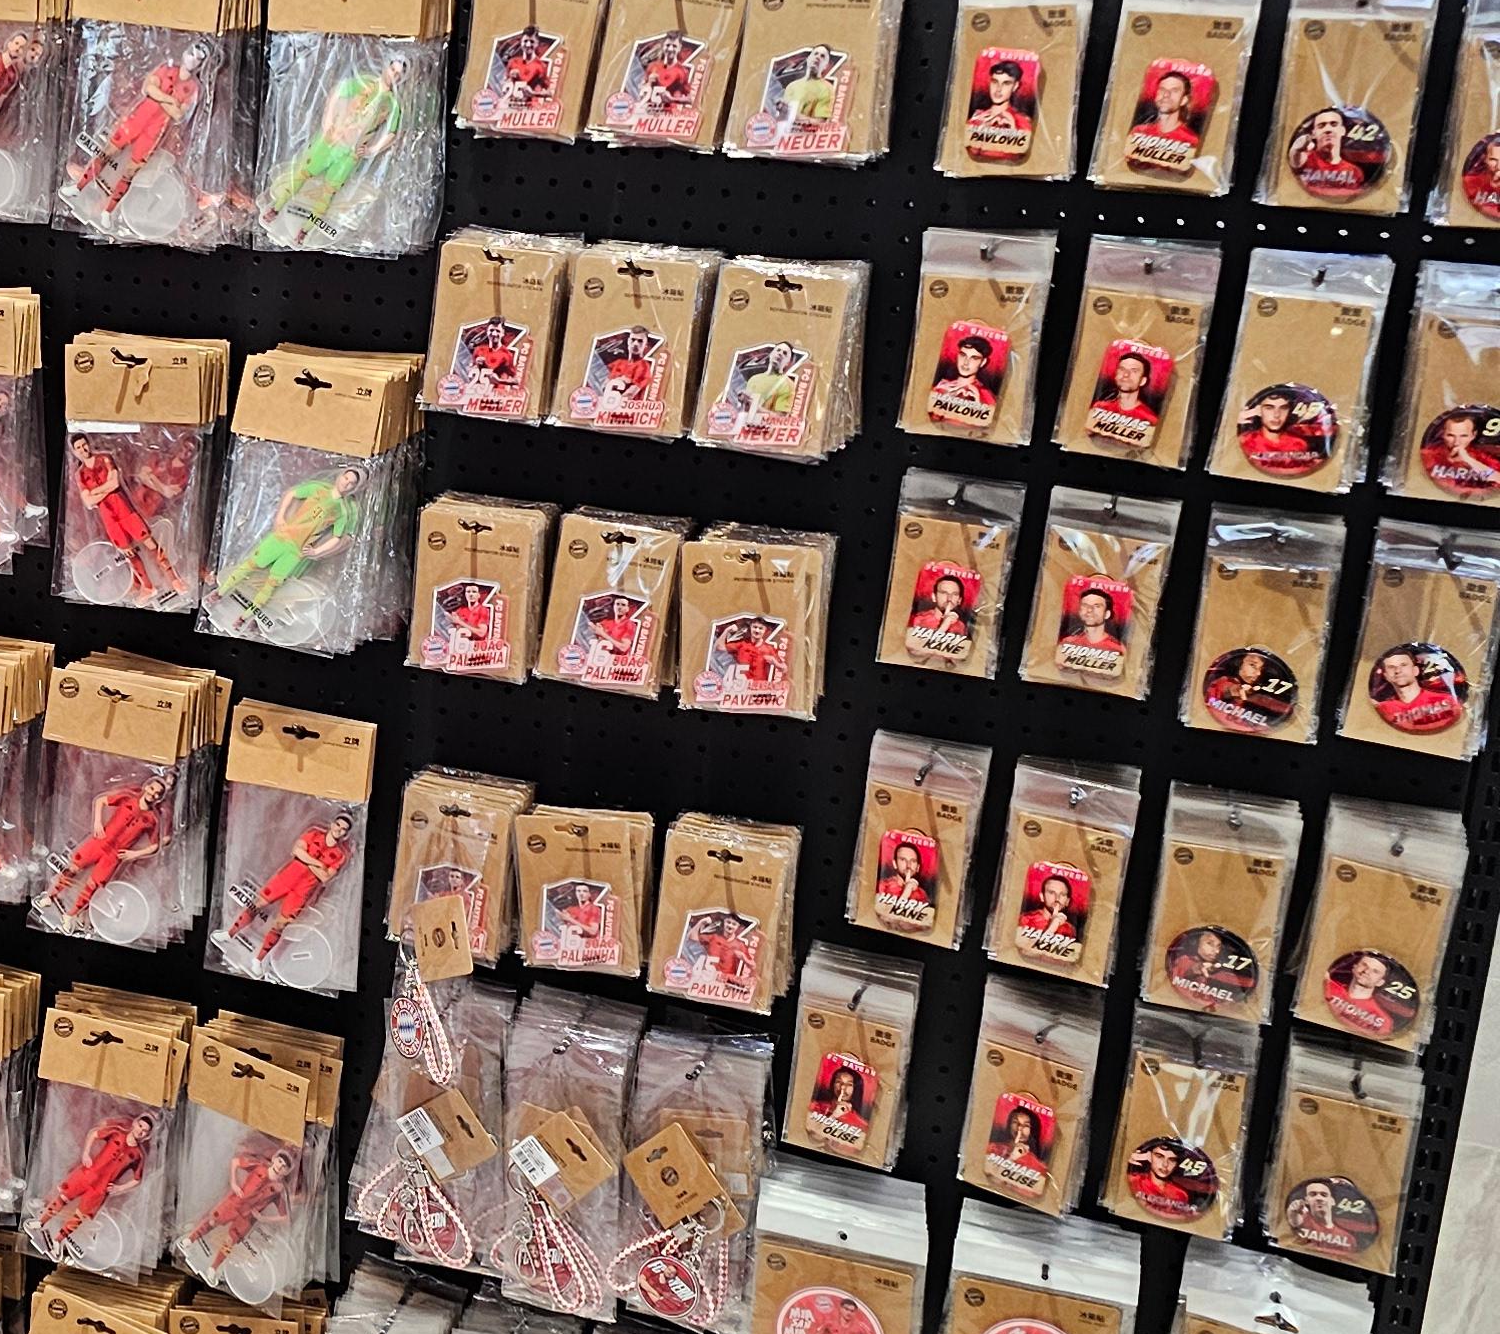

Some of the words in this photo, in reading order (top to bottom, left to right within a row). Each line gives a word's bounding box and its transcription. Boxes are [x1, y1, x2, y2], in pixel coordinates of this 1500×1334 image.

[778, 132, 842, 151] NEUER
[969, 132, 1027, 148] PAVLOVIĆ
[1348, 123, 1381, 142] 42
[1131, 132, 1192, 155] THOMAS
[1131, 145, 1186, 165] MÜLLER
[1300, 168, 1358, 186] JAMAL
[307, 212, 339, 239] NEUER
[1164, 314, 1195, 326] BADGE
[1333, 316, 1367, 328] BADGE
[465, 368, 493, 396] 25
[649, 365, 666, 403] BAYERN
[602, 377, 627, 411] 6
[791, 381, 811, 420] BAYERN
[620, 399, 662, 412] JOSHUA
[932, 398, 991, 421] PAVLOVIĆ
[759, 414, 804, 428] MANUEL
[1091, 408, 1151, 431] THOMAS
[736, 425, 801, 444] NEUER
[1093, 421, 1145, 442] MÜLLER
[1430, 463, 1495, 483] HARRY
[1292, 580, 1324, 591] BADGE
[247, 601, 275, 630] NEUER
[448, 627, 471, 654] 16
[912, 625, 968, 648] HARRY
[588, 639, 611, 666] 16
[922, 639, 966, 656] KANE
[1061, 643, 1121, 662] THOMAS
[448, 652, 504, 669] PALHINHA
[1063, 655, 1117, 673] MÜLLER
[585, 665, 644, 683] PALHINHA
[723, 664, 749, 692] 45
[1263, 677, 1294, 696] 17
[1208, 697, 1269, 727] MICHAEL
[1394, 699, 1452, 723] THOMAS
[936, 811, 963, 824] BADGE
[1090, 843, 1118, 858] BADGE
[1247, 866, 1277, 878] BADGE
[877, 892, 930, 912] HARRY
[1409, 892, 1442, 907] BADGE
[888, 905, 928, 922] KANE
[559, 924, 584, 951] 16
[1021, 925, 1077, 948] HARRY
[559, 949, 618, 965] PALHINHA
[1034, 938, 1076, 958] KANE
[691, 955, 718, 983] 45
[1222, 953, 1252, 971] 17
[1171, 975, 1235, 1003] MICHAEL
[1384, 980, 1417, 1000] 25
[1329, 994, 1385, 1029] THOMAS
[869, 1036, 896, 1049] BADGE
[1050, 1076, 1079, 1092] BADGE
[810, 1110, 864, 1138] MICHAEL
[822, 1125, 860, 1145] OLISE
[987, 1152, 1042, 1181] MICHAEL
[1178, 1157, 1208, 1177] 45
[1000, 1168, 1038, 1190] OLISE
[1336, 1197, 1366, 1215] 42
[1298, 1227, 1352, 1248] JAMAL
